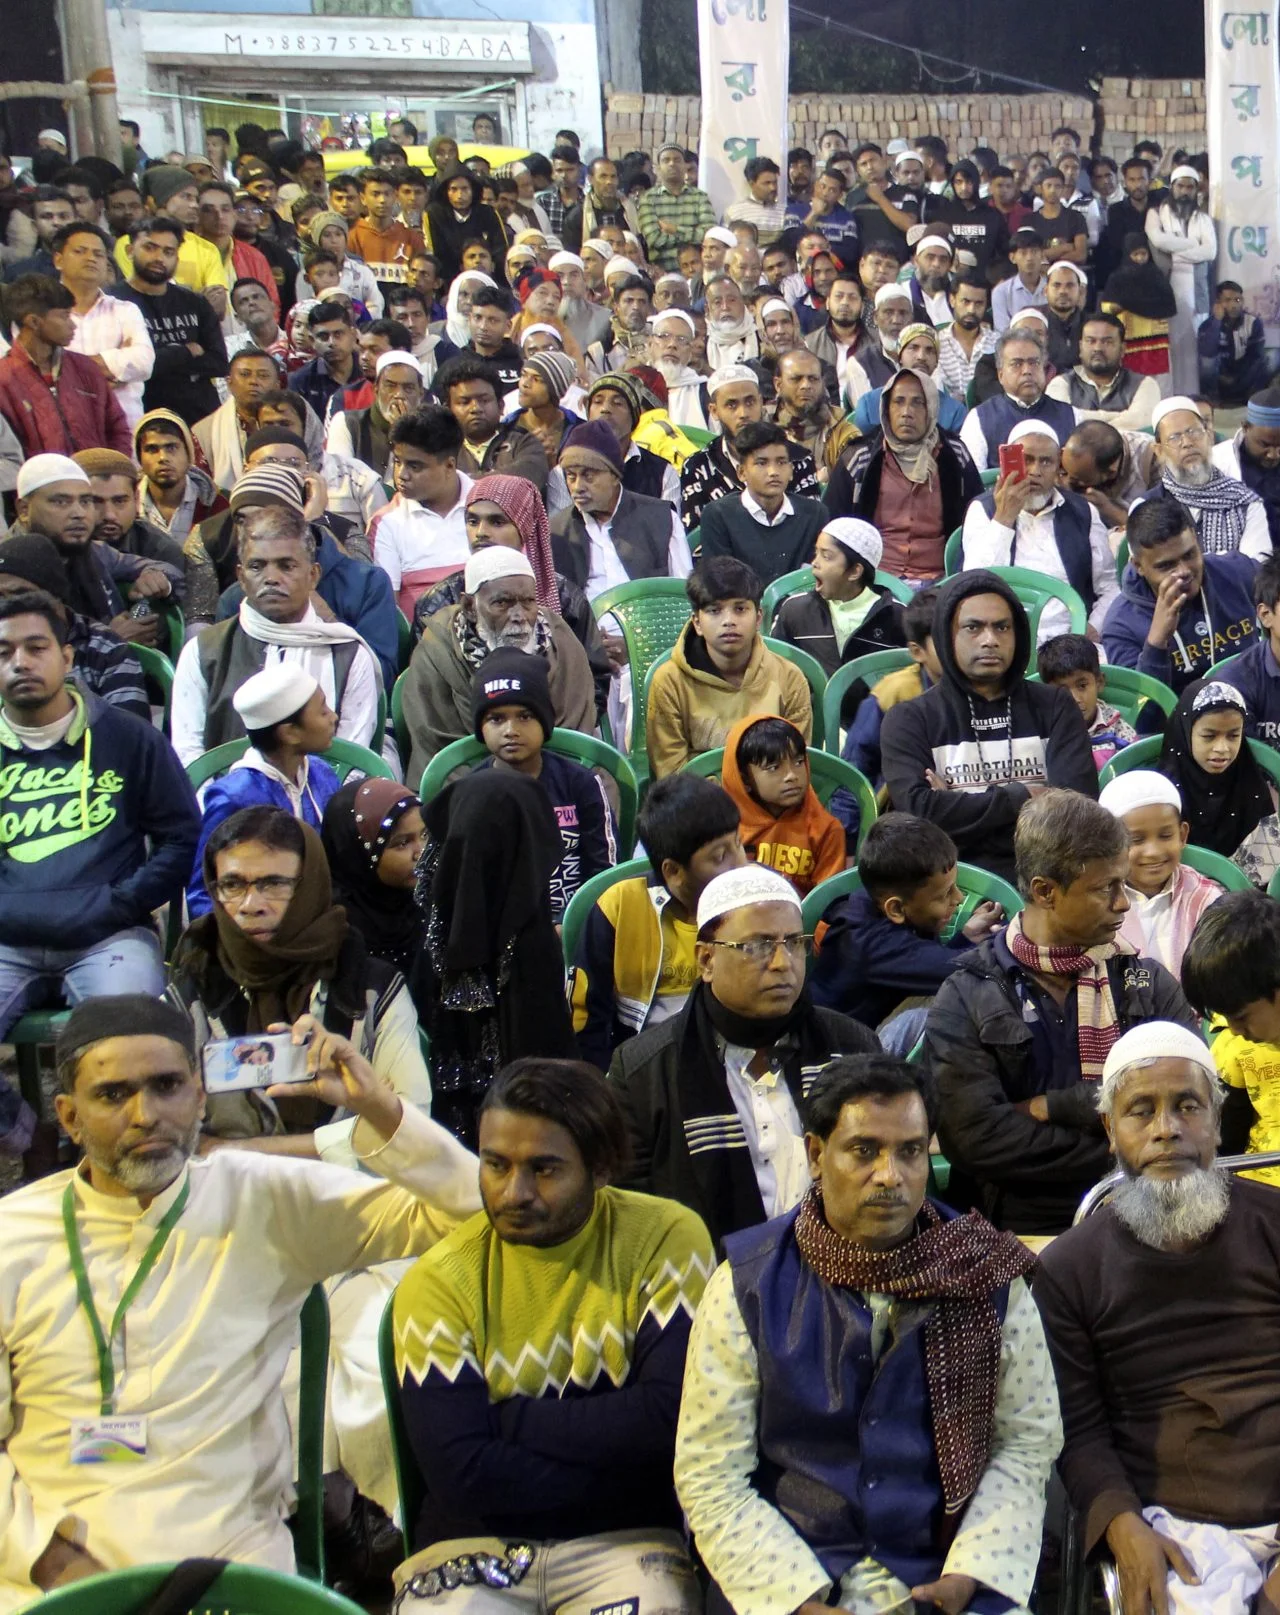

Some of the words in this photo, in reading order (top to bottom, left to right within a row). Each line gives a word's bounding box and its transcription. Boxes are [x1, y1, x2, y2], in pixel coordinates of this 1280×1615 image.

[145, 313, 199, 331] ALMAIN
[153, 330, 187, 343] PARIS
[1171, 617, 1254, 667] ERSACE
[484, 678, 521, 694] NIKE
[945, 755, 1043, 785] STRUCTURAL
